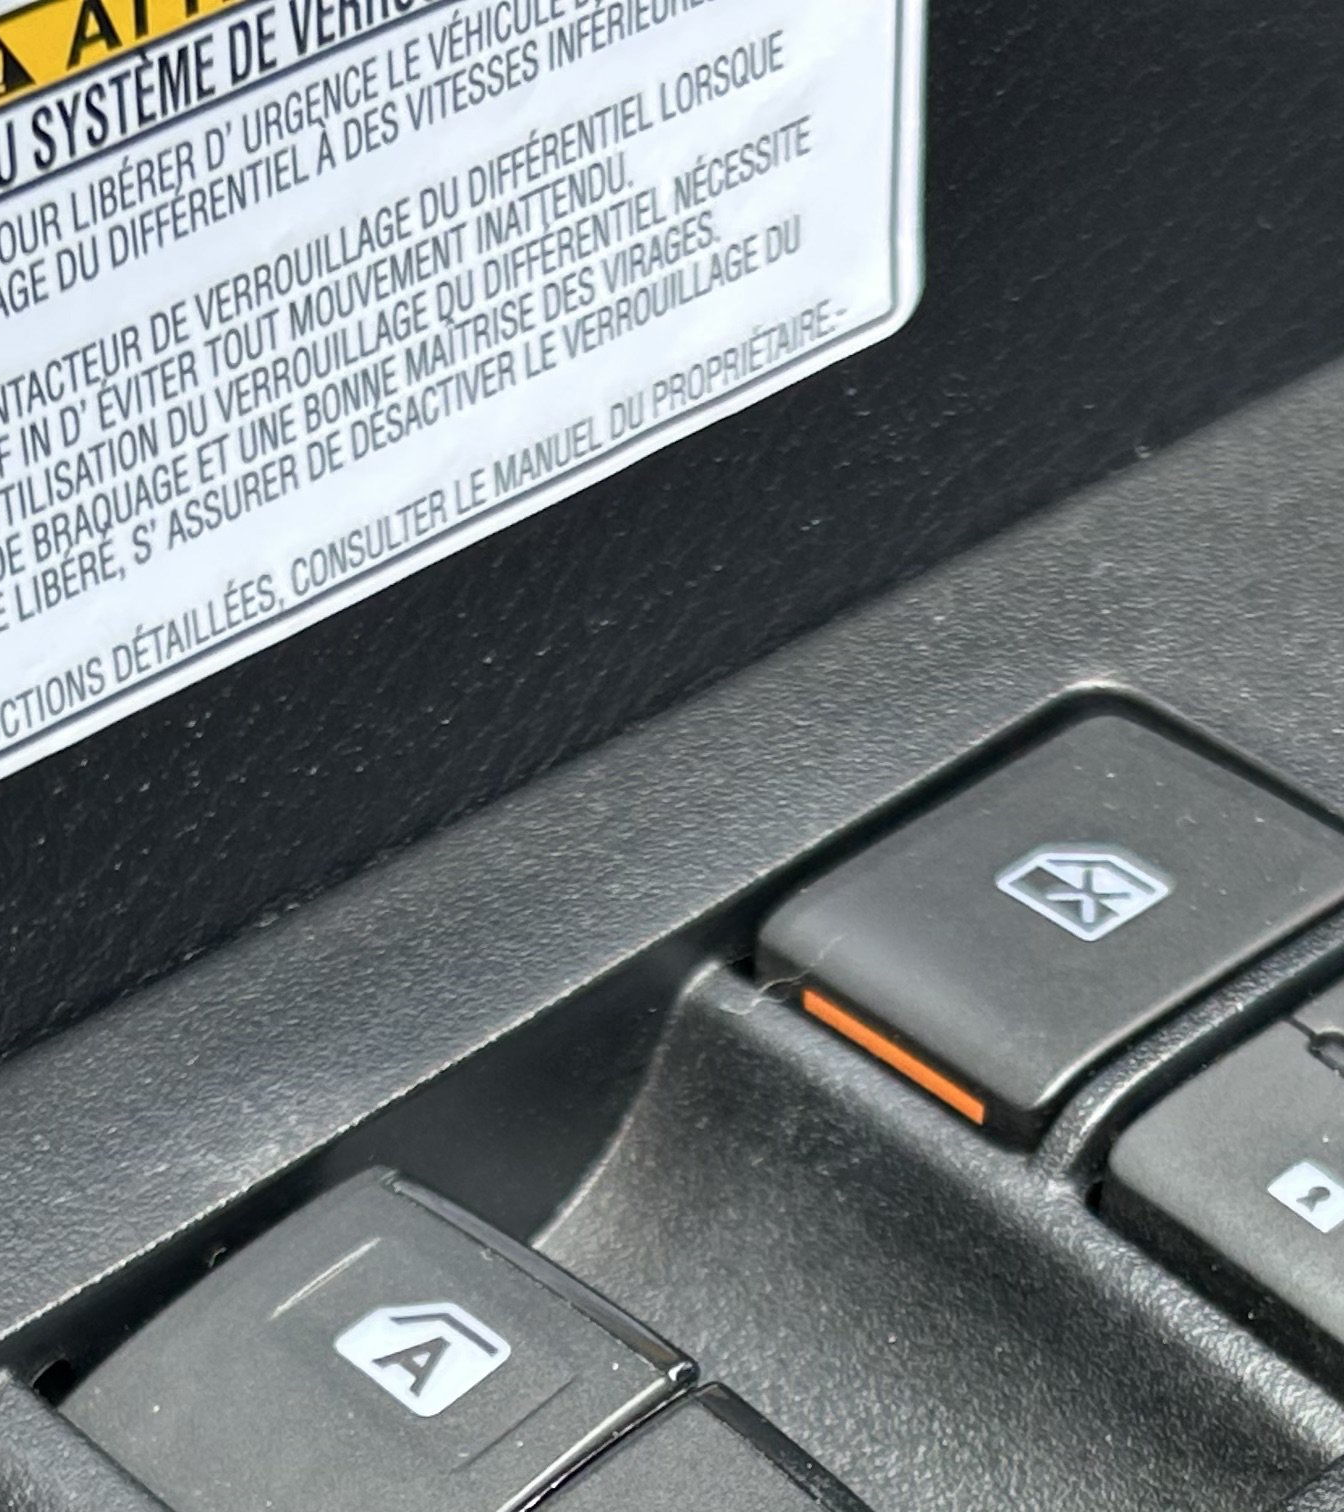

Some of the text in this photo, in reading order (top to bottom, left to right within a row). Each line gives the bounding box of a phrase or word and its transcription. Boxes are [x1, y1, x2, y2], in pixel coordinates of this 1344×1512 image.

[30, 33, 216, 173] SYSTÈME
[227, 5, 278, 87] DE
[55, 234, 100, 293] DU
[107, 143, 310, 270] DIFFÉRENTIEL
[314, 118, 337, 176] À
[343, 100, 400, 162] DES
[404, 39, 540, 132] VITESSES
[69, 140, 197, 233] LIBÉRER
[241, 56, 379, 155] URGENCE
[386, 37, 421, 92] LE
[149, 299, 191, 356] DE
[193, 196, 413, 331] VERROUILLAGE
[418, 175, 460, 231] DU
[467, 92, 654, 209] DIFFÉRENTIEL
[660, 29, 784, 122] LORSQUE
[13, 537, 126, 623] LIBÉRÉ,
[167, 453, 300, 551] ASSURER
[305, 429, 345, 483] DE
[349, 349, 517, 462] DÉSACTIVER
[524, 329, 557, 380] LE
[561, 234, 759, 359] VERROUILLAGE
[766, 215, 800, 264] DU
[31, 453, 192, 564] BRAQUAGE
[196, 432, 230, 485] ET
[237, 402, 298, 464] UNE
[303, 353, 398, 435] BONNE
[542, 265, 596, 323] DES
[601, 209, 721, 294] VIRAGES.
[96, 349, 200, 432] ÉVITER
[203, 307, 280, 378] TOUT
[288, 221, 467, 341] MOUVEMENT
[475, 151, 633, 255] INATTENDU.
[166, 393, 209, 450] DU
[213, 289, 429, 424] VERROUILLAGE
[435, 269, 475, 323] DU
[482, 186, 668, 300] DIFFÉRENTIEL
[673, 115, 811, 214] NÉCESSITE
[111, 573, 285, 685] DÉTAILLÉES,
[290, 488, 448, 597] CONSULTER
[454, 467, 487, 516] LE
[492, 416, 603, 498] MANUEL
[609, 391, 644, 441] DU
[372, 1336, 452, 1398] A
